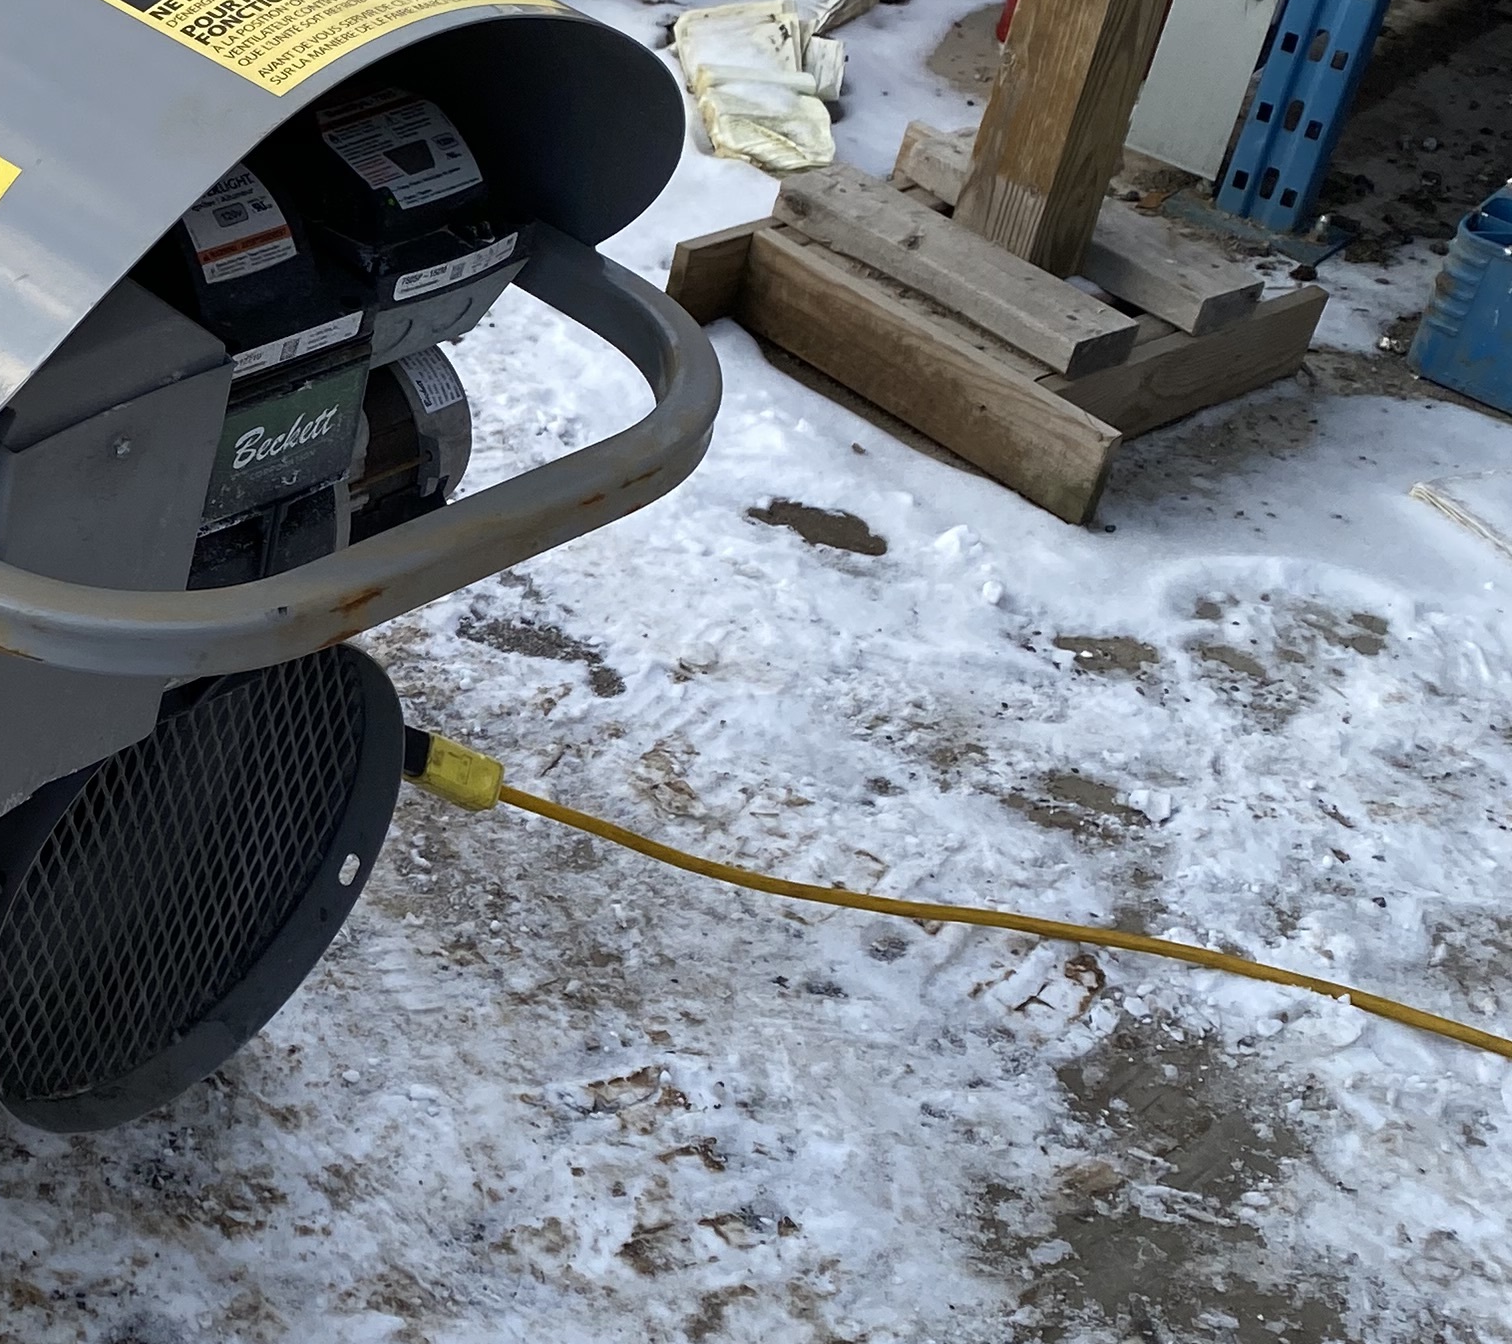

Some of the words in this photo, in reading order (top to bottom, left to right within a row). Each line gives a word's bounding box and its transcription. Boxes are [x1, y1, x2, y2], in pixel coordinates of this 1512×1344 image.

[180, 0, 243, 38] POUR
[220, 35, 240, 46] LA
[235, 5, 289, 36] POSITION
[223, 15, 296, 59] VENTILATEUR
[238, 48, 266, 67] QUE
[260, 25, 304, 50] L'UNITÉ
[300, 13, 325, 28] SOIT
[258, 50, 295, 77] AVANT
[292, 41, 313, 53] DE
[307, 25, 342, 44] VOUS
[338, 9, 379, 28] SERVIR
[269, 67, 296, 85] SUR
[291, 58, 312, 69] LA
[354, 23, 375, 33] DE
[371, 17, 389, 26] LE
[233, 405, 339, 470] Beckett
